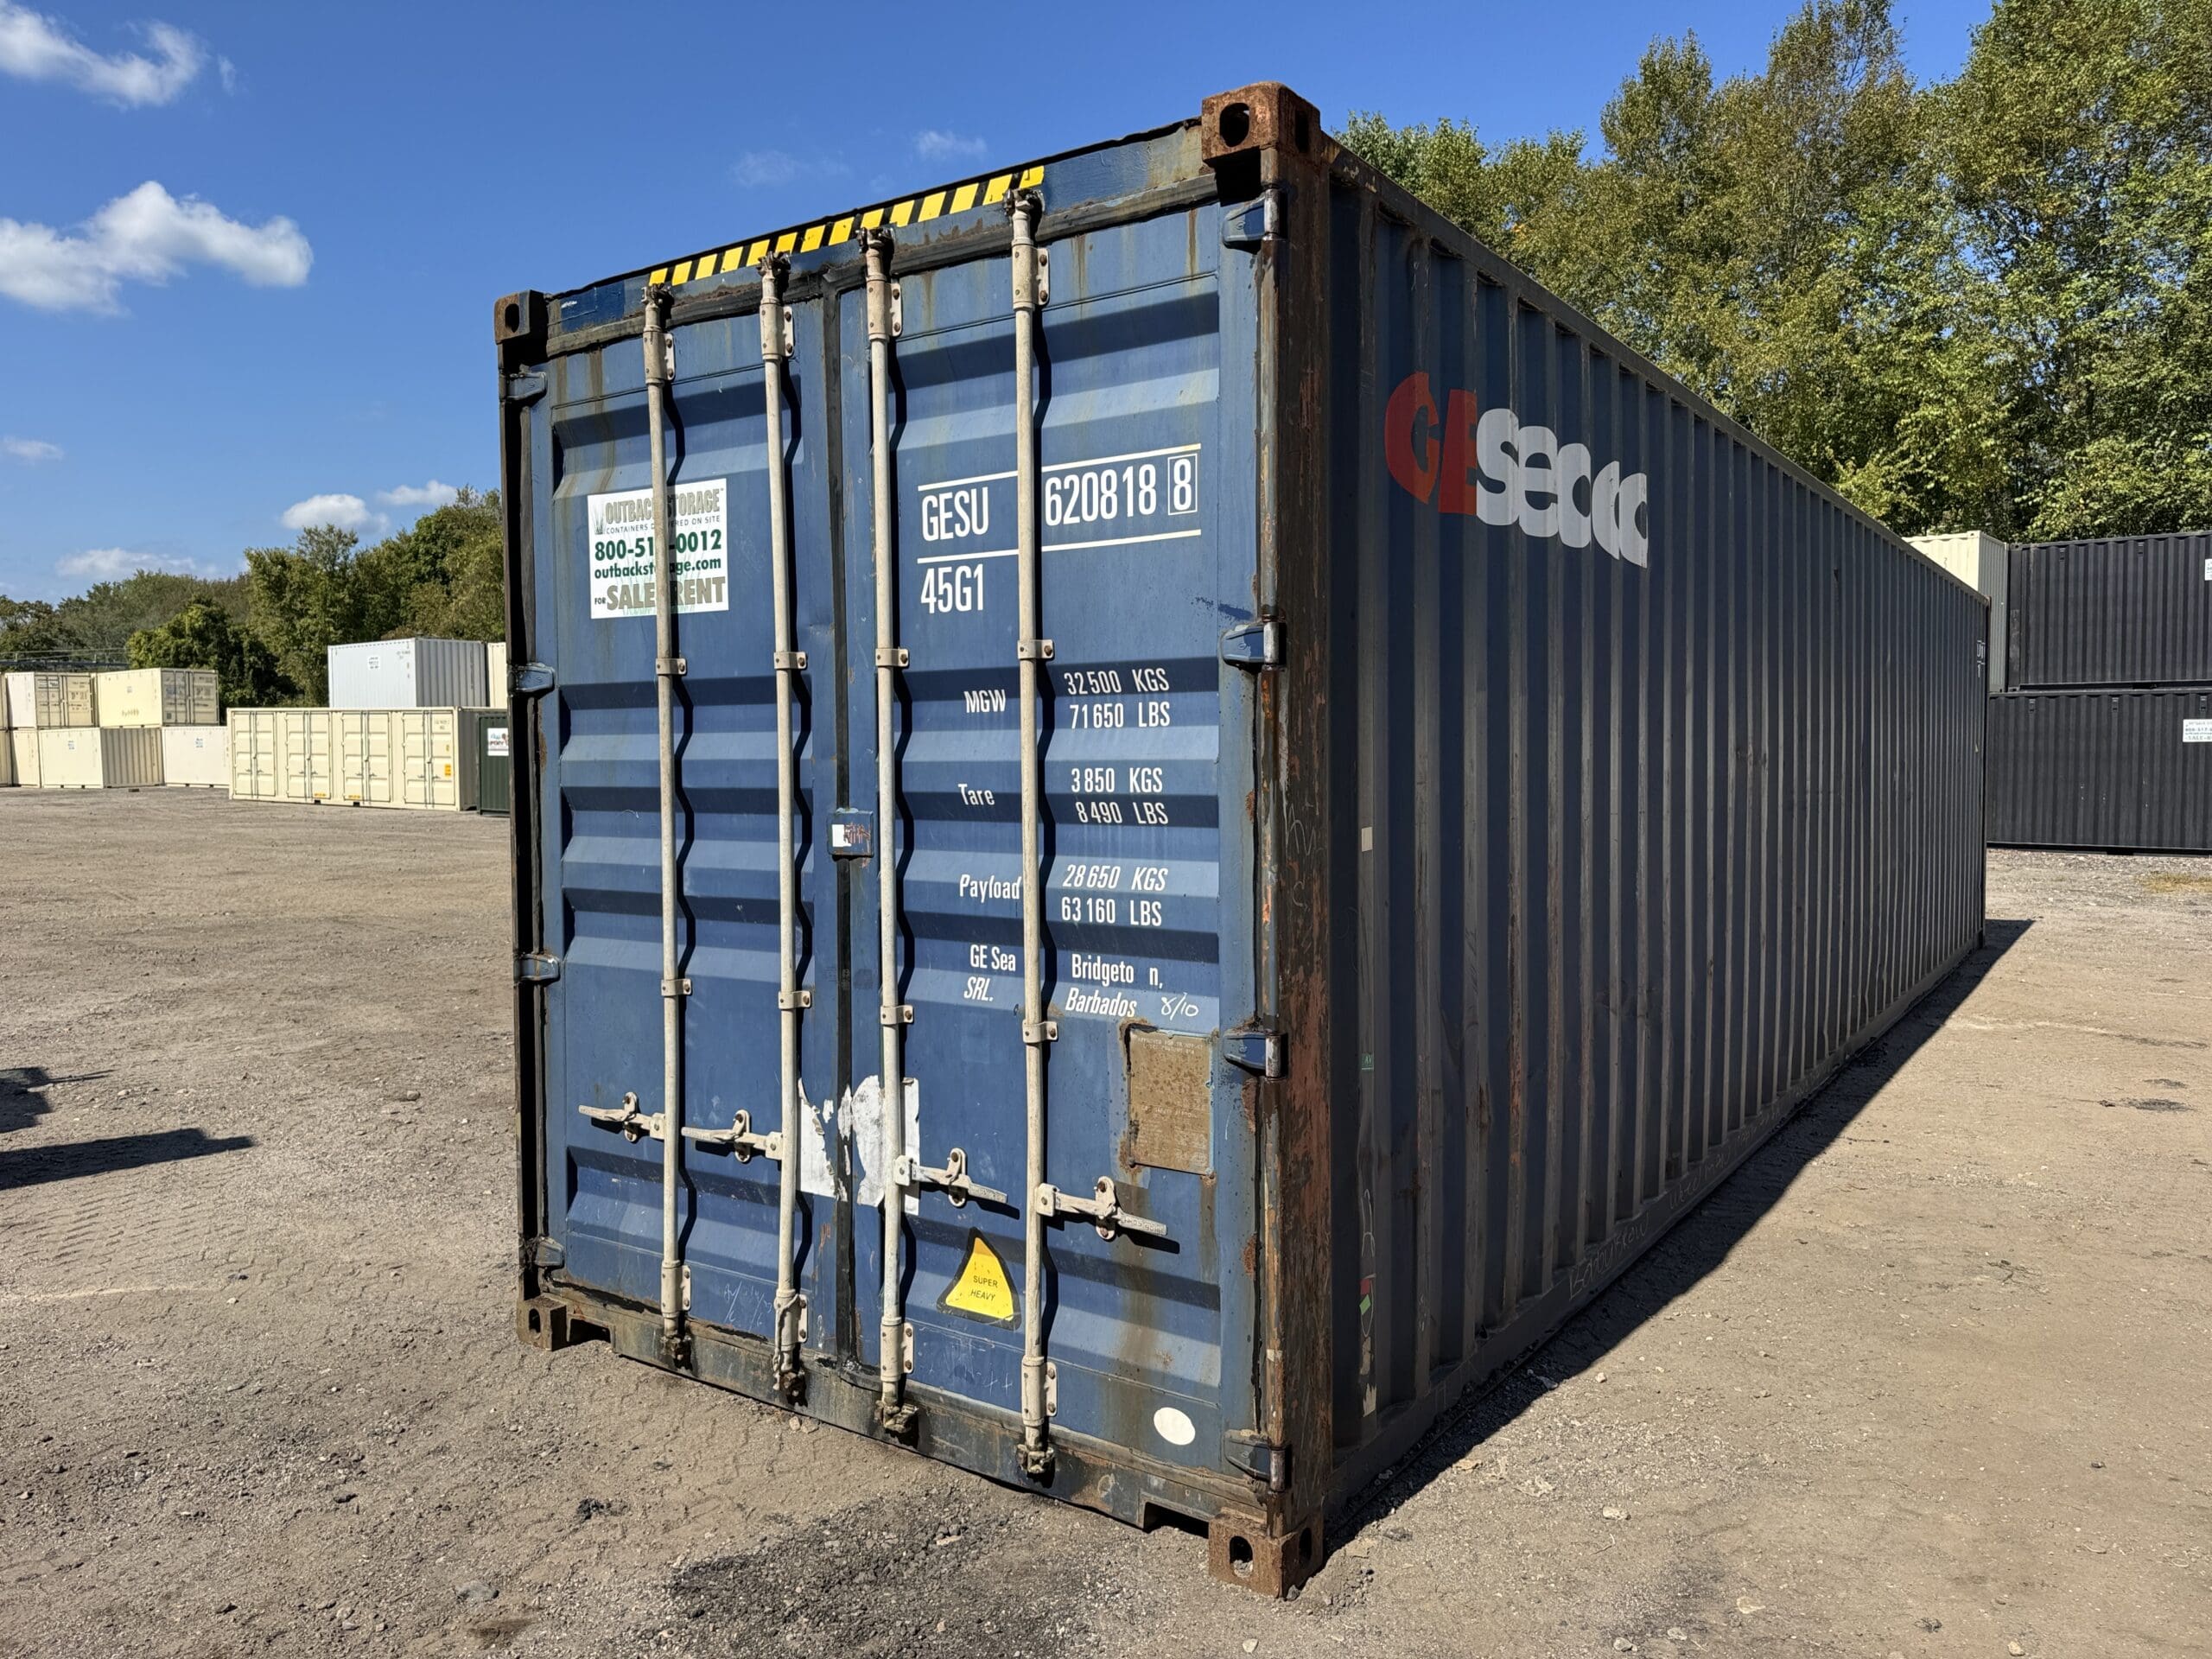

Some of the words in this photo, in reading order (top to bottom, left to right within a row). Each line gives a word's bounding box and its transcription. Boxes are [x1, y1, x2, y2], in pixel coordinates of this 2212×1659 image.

[606, 497, 655, 524] OUTBAC
[922, 486, 989, 542] GESU
[1044, 463, 1157, 526] 620818
[1173, 458, 1192, 512] 8
[606, 524, 648, 535] CONTAINERS
[705, 515, 720, 524] SITE
[594, 529, 722, 562] 800-51-0012
[594, 557, 721, 579] outbackstage.com
[594, 596, 606, 605] FOR
[607, 582, 656, 611] SALE
[920, 563, 984, 613] 45G1
[1131, 668, 1170, 692] KGS
[963, 689, 1007, 714] MGW
[1137, 702, 1171, 728] LBS
[1129, 767, 1163, 793] KGS
[957, 783, 995, 805] Tare
[1132, 801, 1169, 825] LBS
[959, 874, 1022, 904] Payload
[1130, 867, 1169, 892] KGS
[1130, 899, 1162, 927] LBS
[969, 944, 988, 969] GE
[991, 946, 1016, 972] Sea
[963, 976, 994, 1002] SRL.
[1065, 987, 1137, 1018] Barbados
[972, 1274, 998, 1288] SUPER
[969, 1288, 996, 1301] HEAVY
